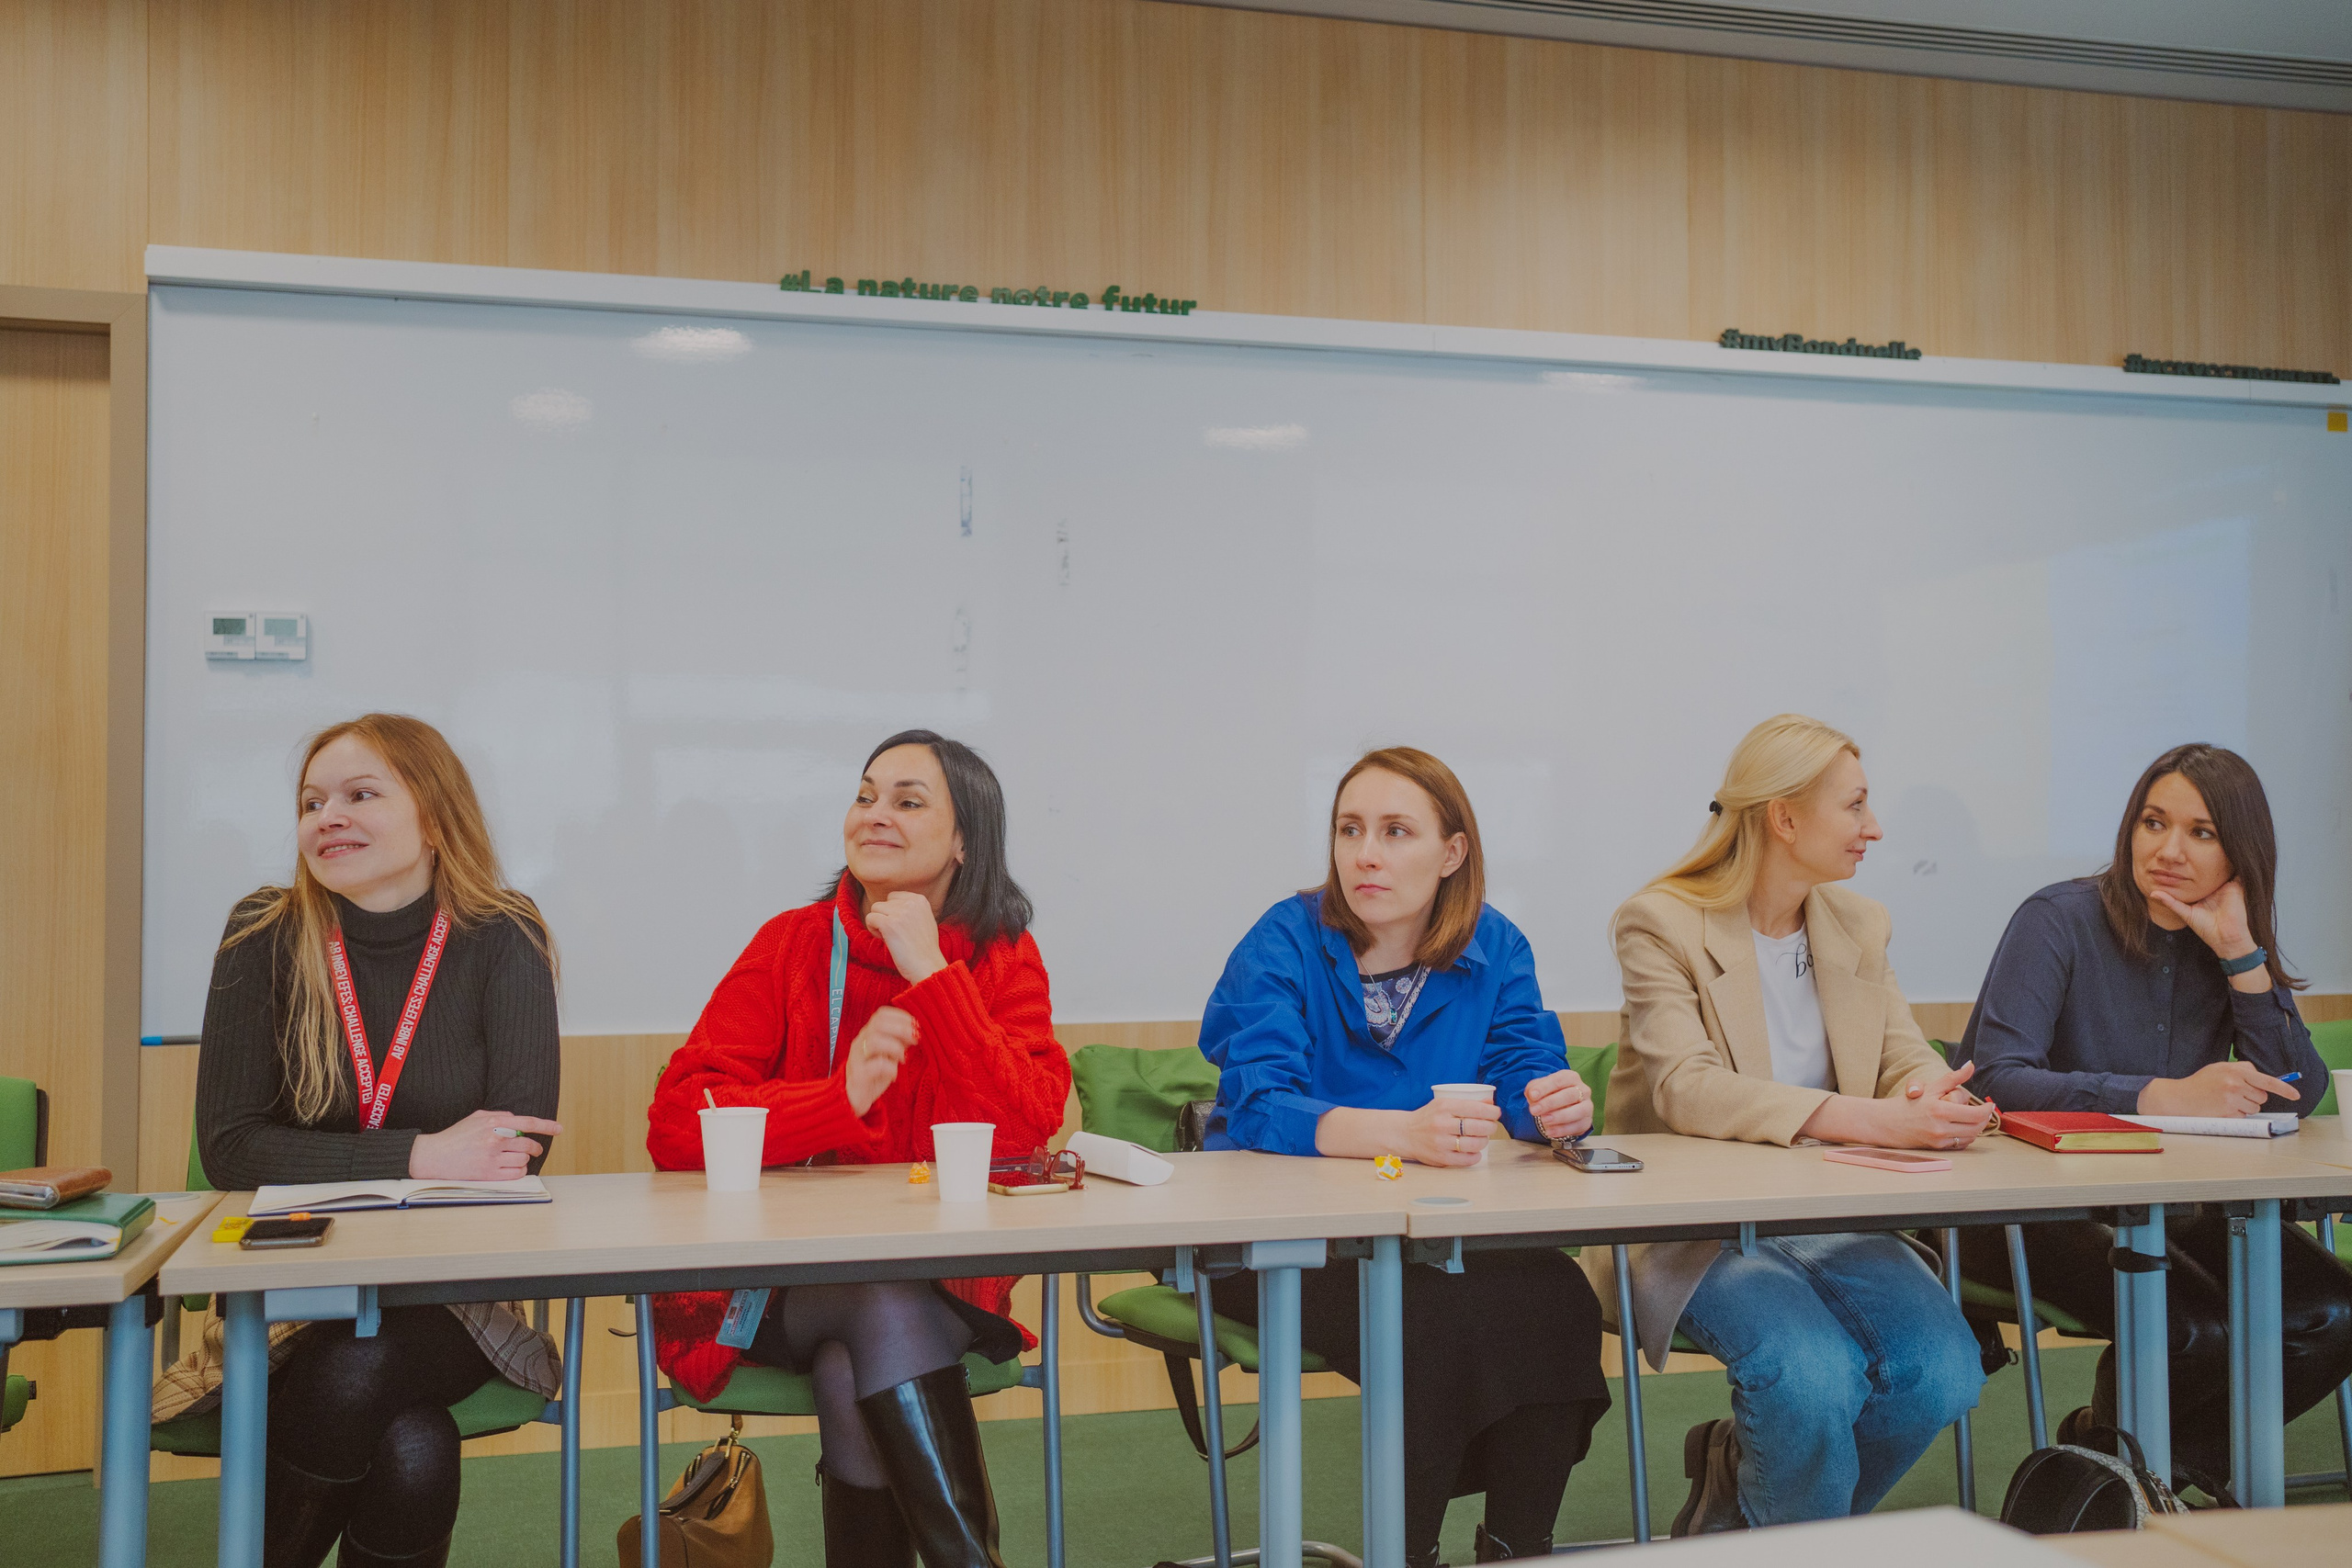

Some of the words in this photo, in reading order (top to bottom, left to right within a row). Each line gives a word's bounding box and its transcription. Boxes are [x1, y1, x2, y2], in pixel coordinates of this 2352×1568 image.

[780, 270, 844, 294] #La
[857, 276, 978, 302] nature
[991, 286, 1090, 310] notre
[1102, 285, 1197, 315] futur
[1720, 328, 1922, 359] #myBonduelle
[432, 908, 449, 946] ACCEPTE
[329, 941, 342, 954] AB
[332, 953, 348, 980] INBEV
[413, 943, 441, 996] CHALLENGE
[337, 980, 354, 1006] EFES:
[404, 995, 424, 1021] EFES:
[831, 988, 842, 1005] EL
[343, 1005, 367, 1058] CHALLENGE
[396, 1017, 415, 1047] INBEV
[390, 1040, 406, 1061] AB
[356, 1058, 374, 1104] ACCEPTED
[368, 1083, 391, 1127] ACCEPTED
